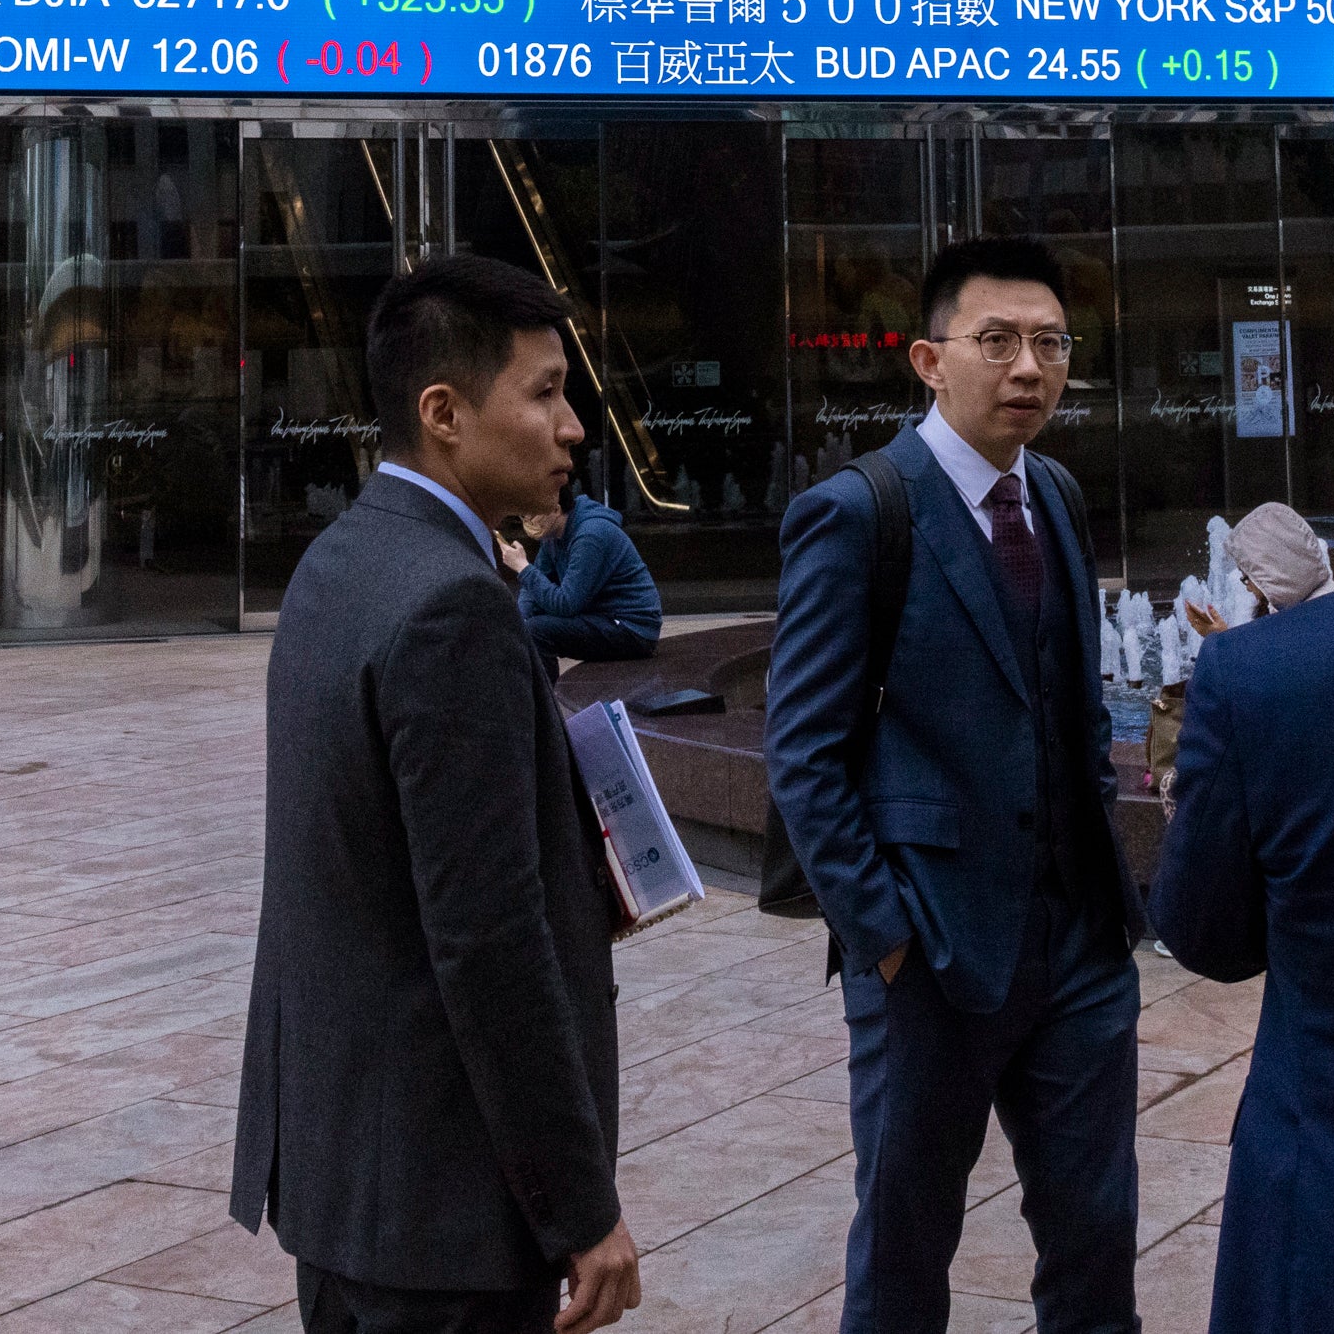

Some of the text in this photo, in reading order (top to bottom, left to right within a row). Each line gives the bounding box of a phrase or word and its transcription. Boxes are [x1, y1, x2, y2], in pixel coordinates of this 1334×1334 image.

[153, 38, 258, 74] 12.06
[479, 42, 591, 77] 01876
[611, 40, 794, 84] 百威亞太
[817, 47, 895, 79] BUD
[906, 47, 1009, 80] APAC
[1028, 48, 1120, 80] 24.55
